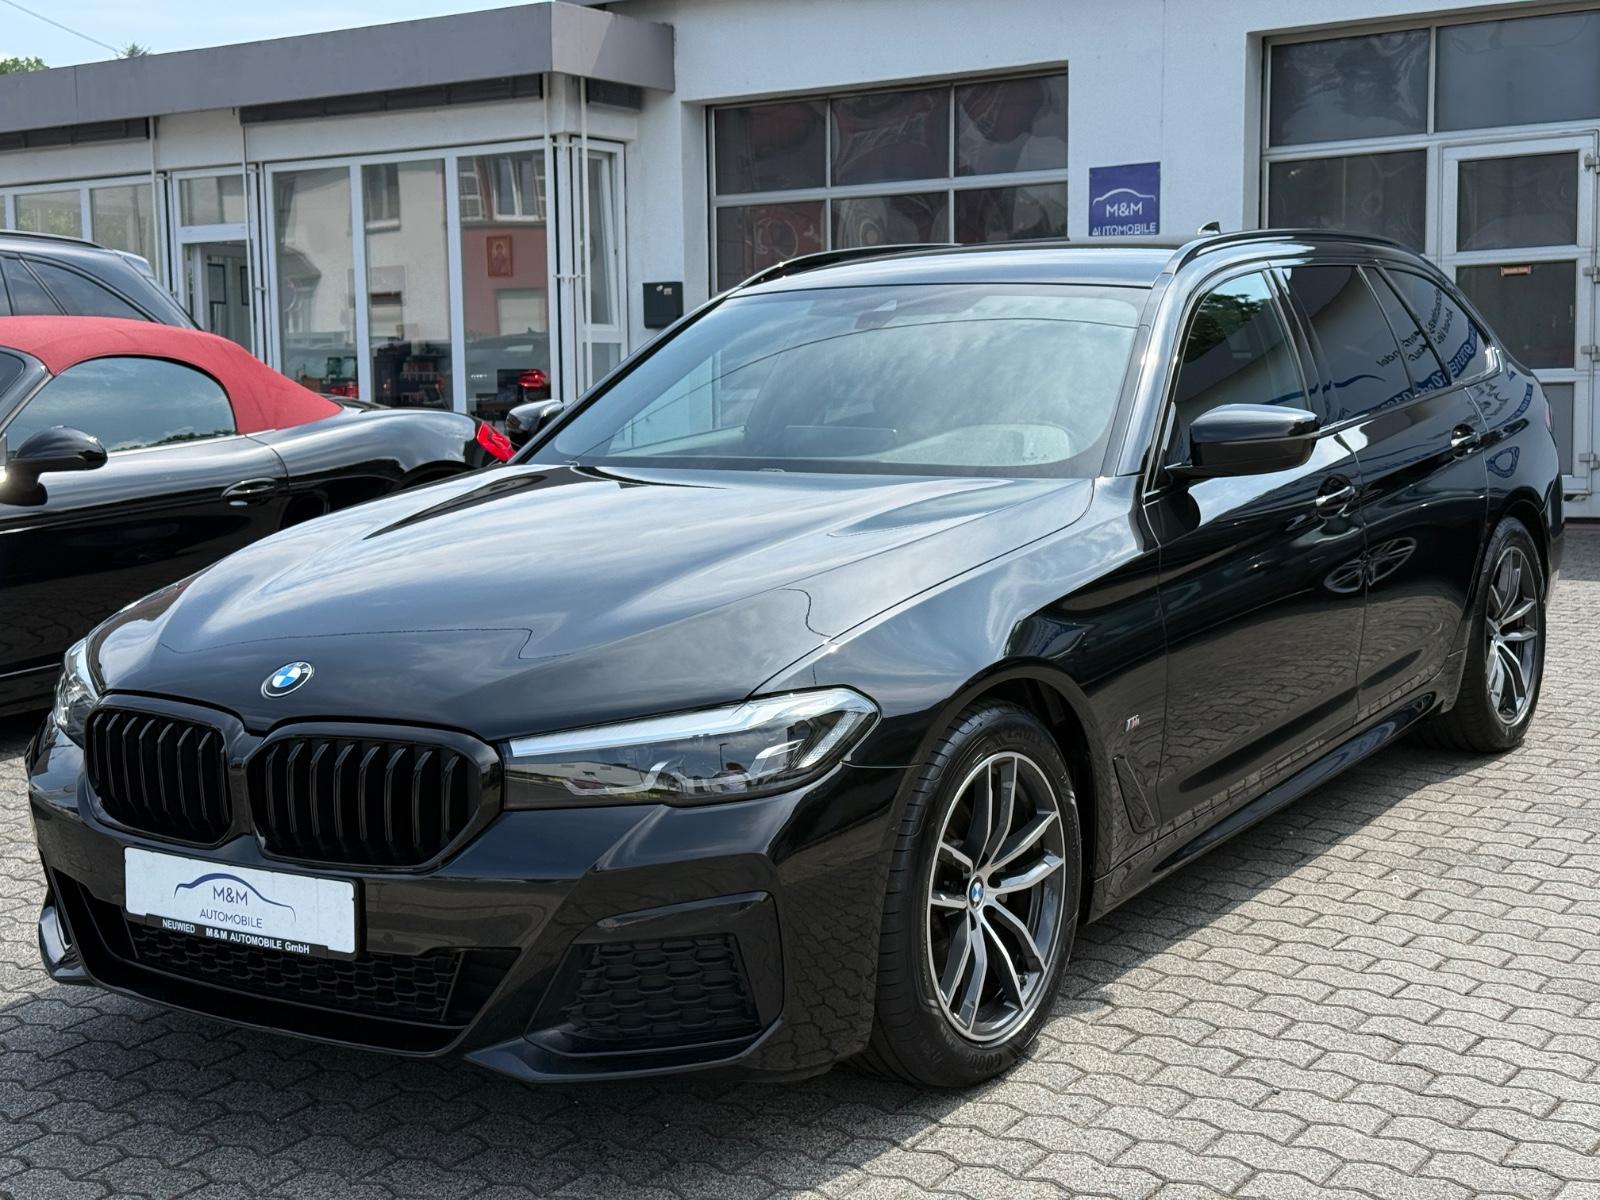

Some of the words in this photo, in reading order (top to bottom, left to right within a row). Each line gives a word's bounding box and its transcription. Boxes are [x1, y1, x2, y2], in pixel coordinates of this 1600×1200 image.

[1106, 201, 1143, 218] M&M
[1092, 222, 1157, 236] AUTOMOBILE
[213, 885, 248, 906] M&M
[200, 908, 263, 929] AUTOMOBILE
[162, 918, 196, 935] NEUWIED
[229, 932, 283, 950] AUTOMOBILE
[284, 941, 310, 954] GmbH
